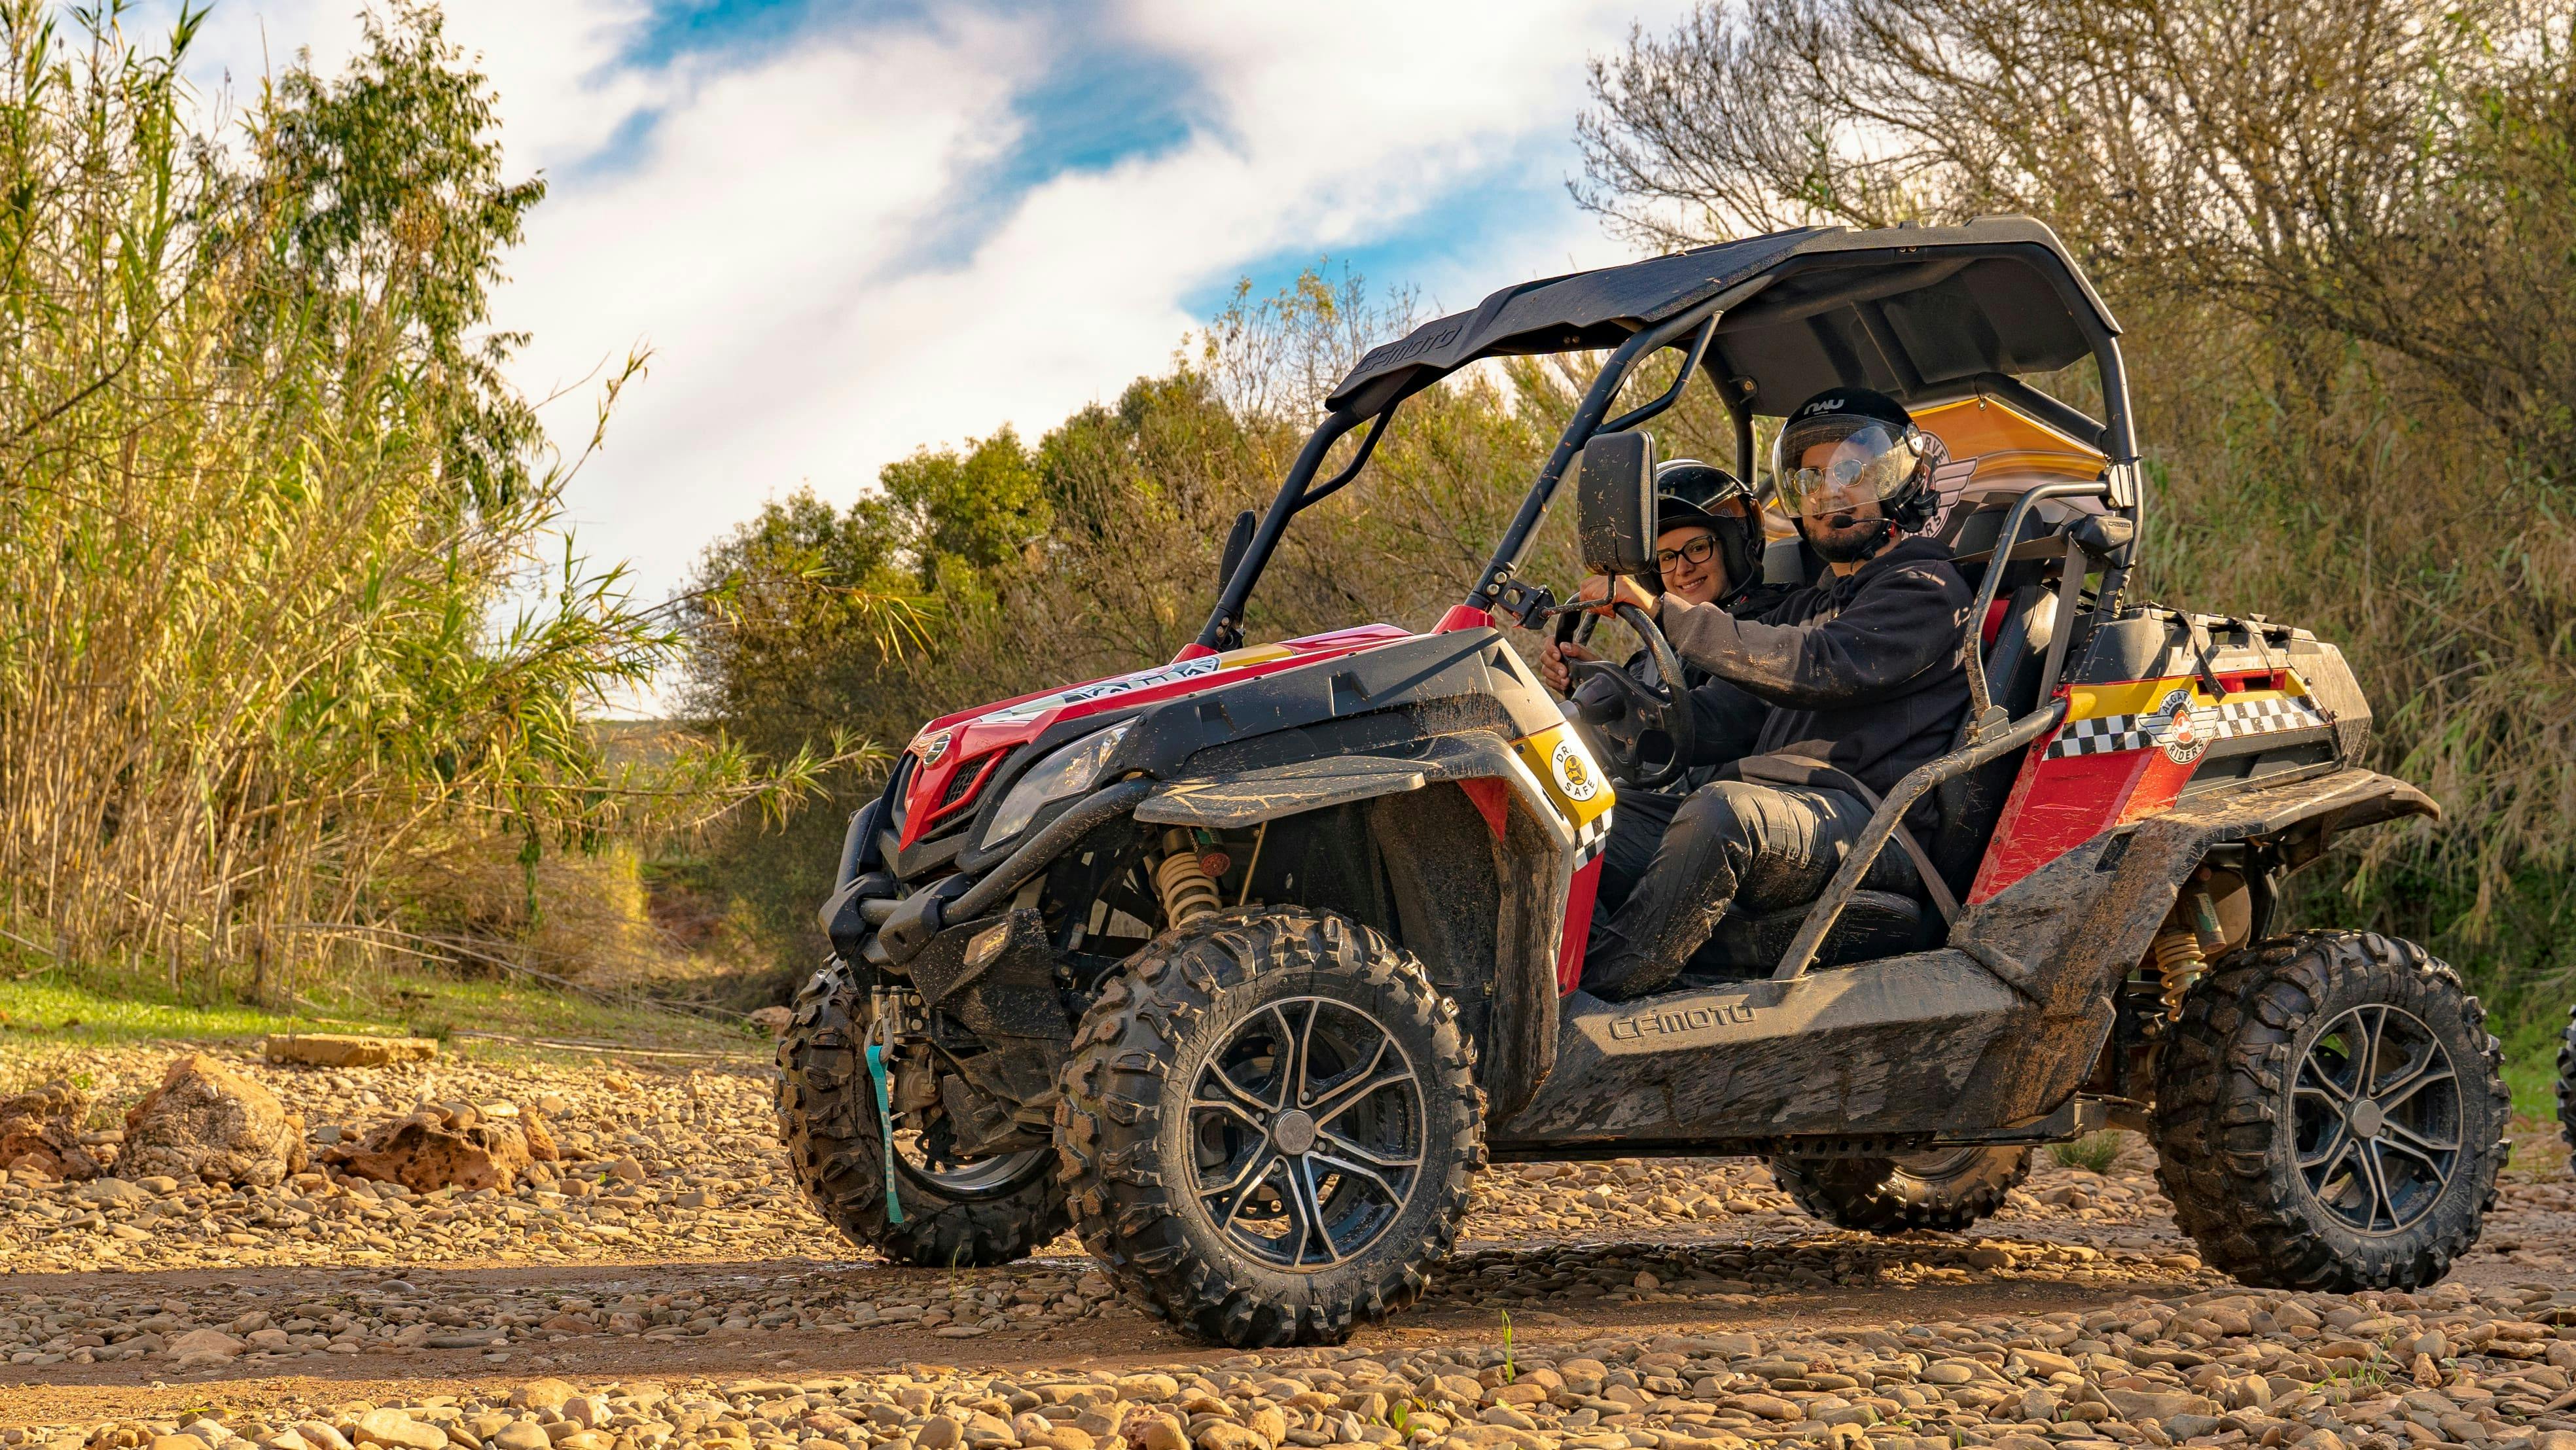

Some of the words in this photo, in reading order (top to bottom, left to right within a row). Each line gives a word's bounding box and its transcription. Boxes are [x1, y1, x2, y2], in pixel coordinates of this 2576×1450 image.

[2162, 692, 2195, 715] ALGARVE
[2168, 739, 2204, 761] RIDERS
[1564, 779, 1595, 798] SAFE
[1607, 1002, 1757, 1040] CFMOTO
